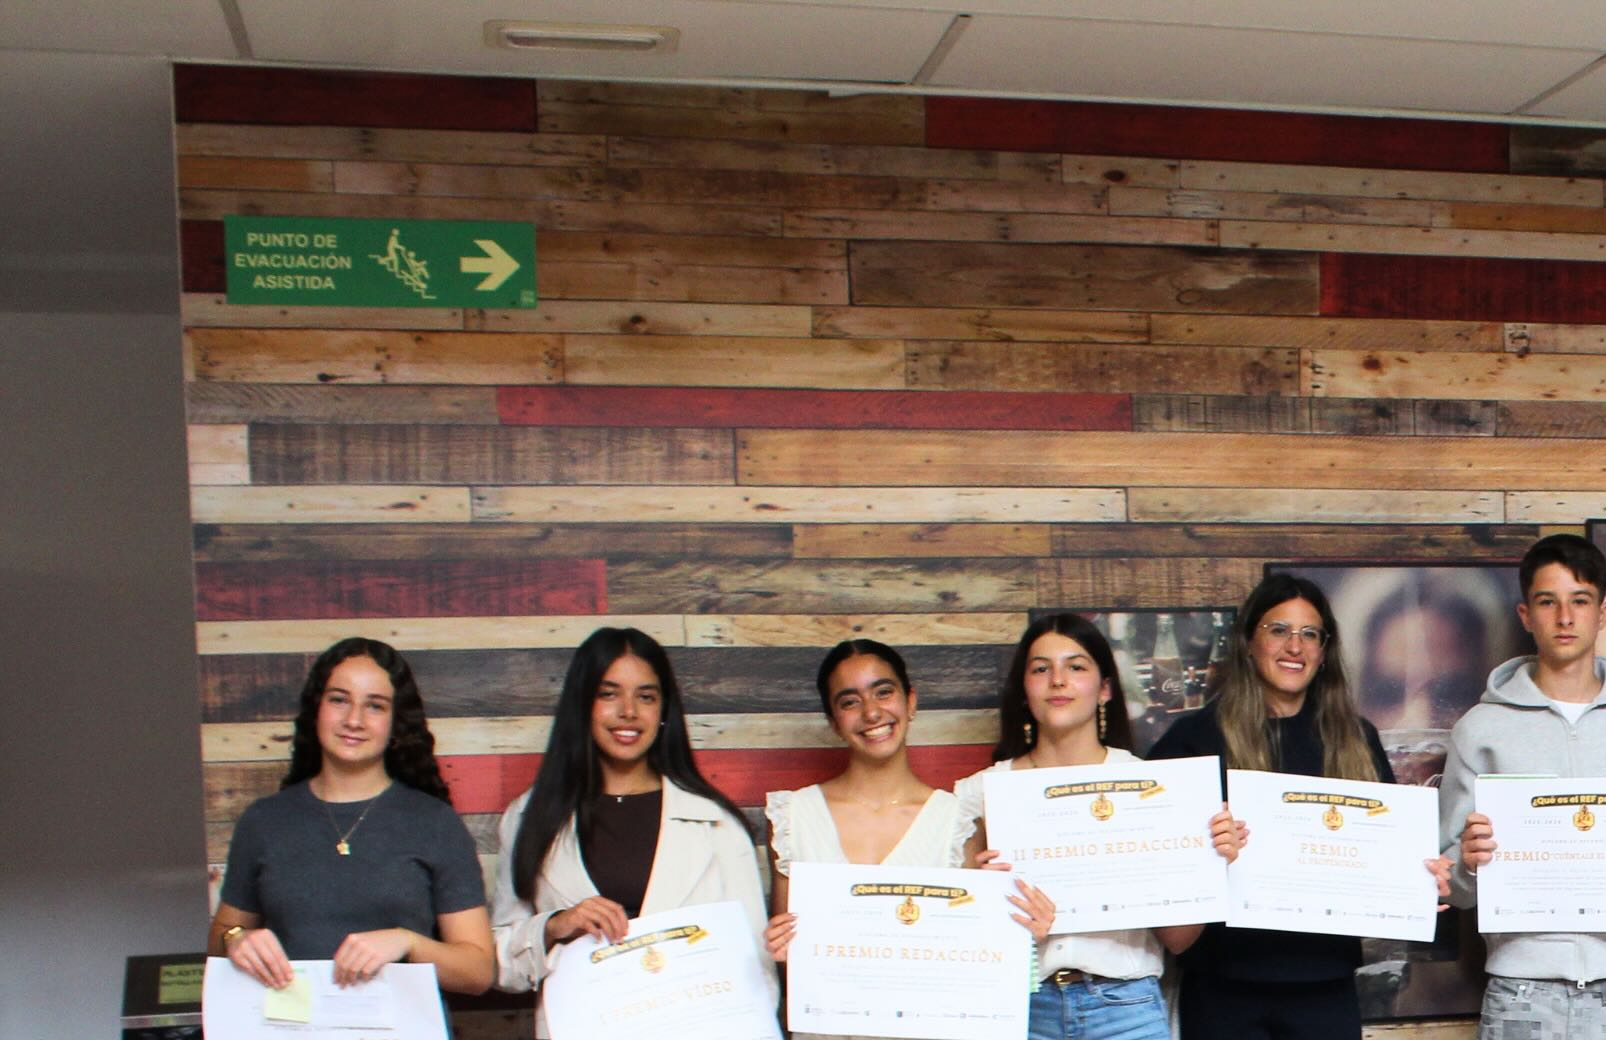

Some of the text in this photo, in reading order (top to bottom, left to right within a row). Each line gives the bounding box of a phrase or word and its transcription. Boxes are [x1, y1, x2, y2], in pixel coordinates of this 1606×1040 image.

[247, 232, 337, 249] PUNTO DE
[234, 252, 352, 271] EVACUACIÓN
[252, 274, 336, 290] ASISTIDA
[1557, 796, 1569, 804] es
[1570, 795, 1579, 803] el
[1580, 795, 1596, 803] REF
[1012, 834, 1205, 861] II PREMIO REDACCIÓN
[1300, 842, 1359, 858] PREMIO
[1494, 850, 1550, 862] PREMIO
[924, 886, 949, 897] para
[813, 943, 1005, 964] I PREMIO REDACCIÓN
